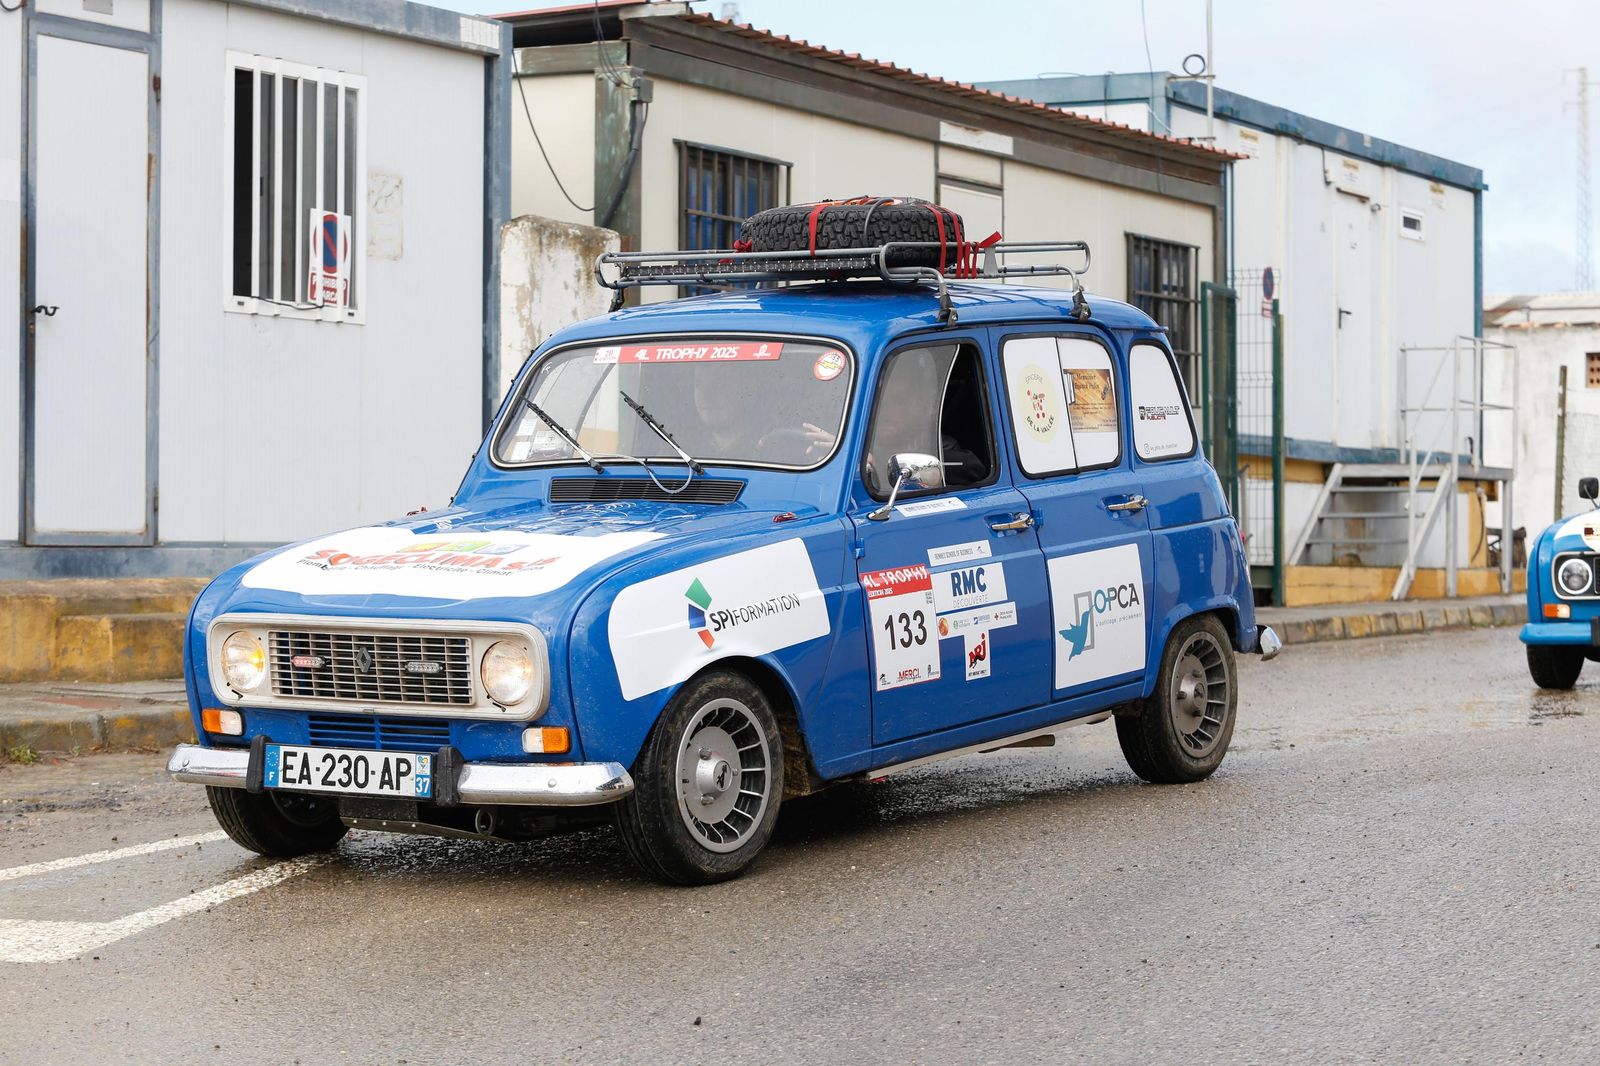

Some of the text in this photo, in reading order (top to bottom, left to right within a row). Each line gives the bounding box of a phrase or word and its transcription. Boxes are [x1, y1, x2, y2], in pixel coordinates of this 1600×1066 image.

[634, 347, 738, 360] 4L TROPHY 2025
[306, 549, 504, 569] SOGECLIMA
[862, 565, 928, 588] 4L TROPHY
[950, 567, 987, 597] RMC
[1094, 583, 1139, 613] OPCA
[884, 610, 927, 650] 133
[268, 751, 430, 794] F EA-230-AP 37
